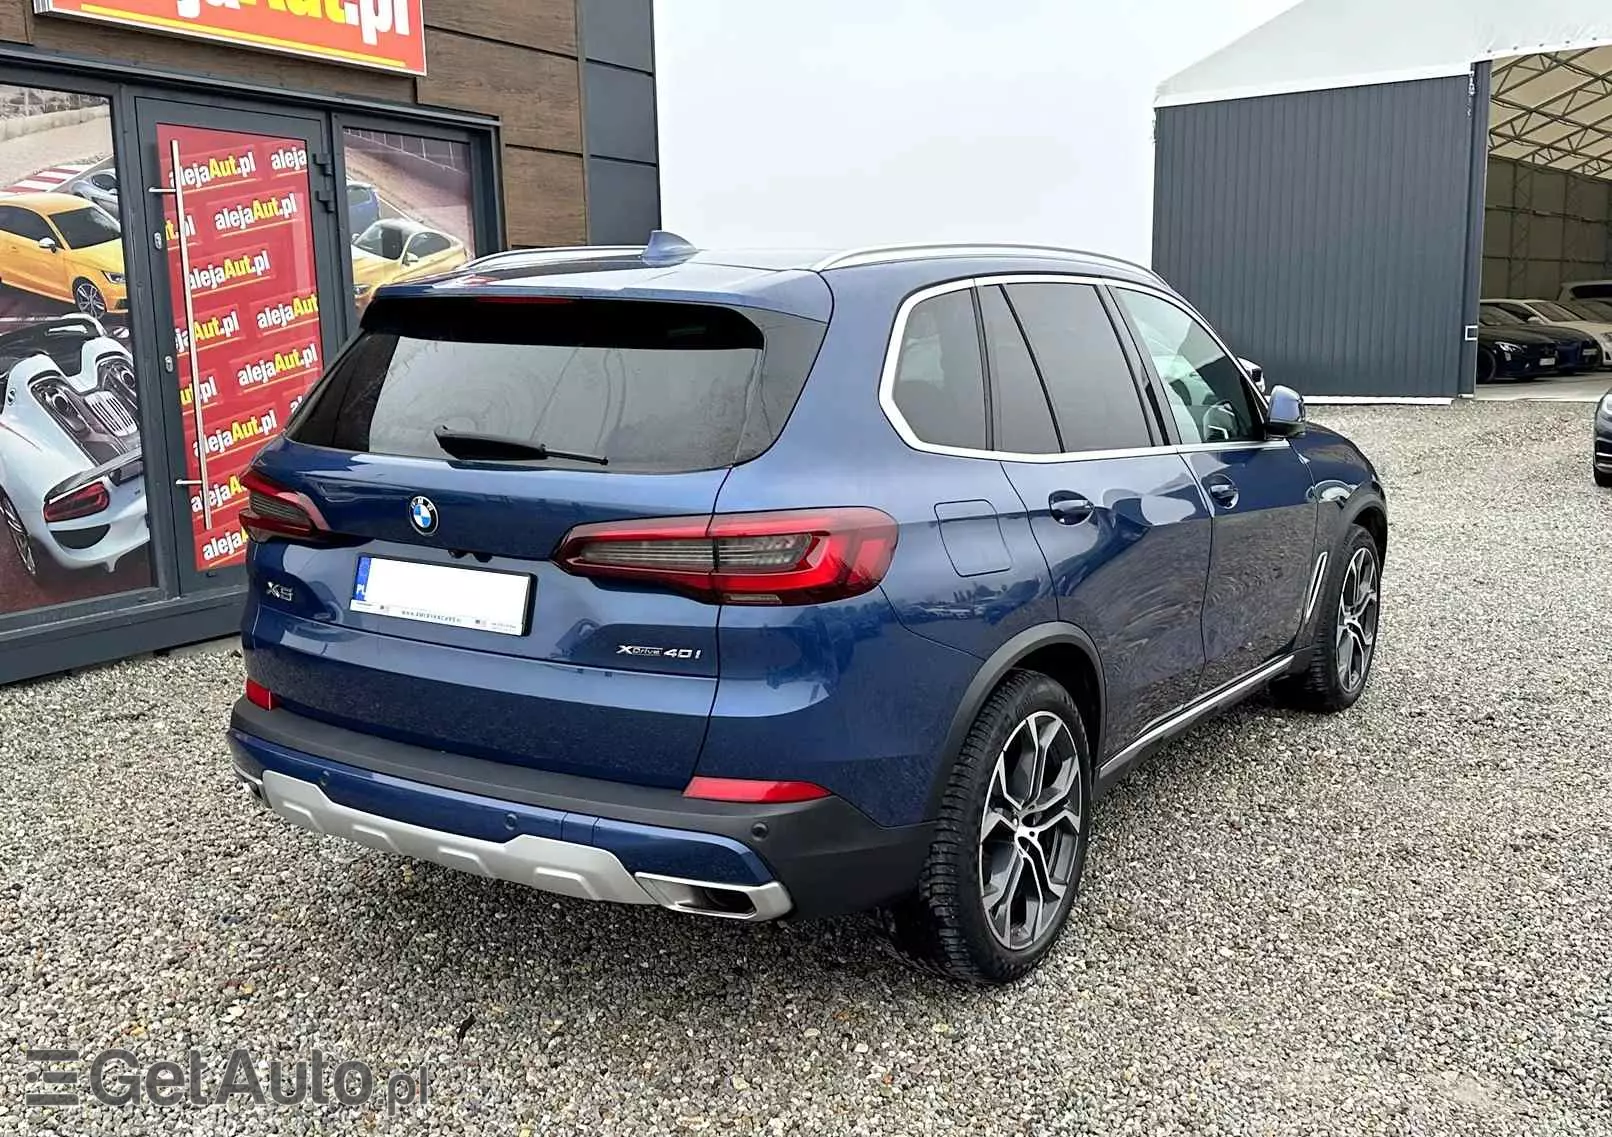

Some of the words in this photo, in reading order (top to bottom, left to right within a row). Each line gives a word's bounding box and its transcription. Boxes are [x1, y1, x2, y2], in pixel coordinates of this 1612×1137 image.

[214, 192, 298, 230] alejaAut.pl
[237, 343, 318, 386] alejaAut.pl
[266, 581, 294, 602] X5
[356, 583, 365, 597] PL
